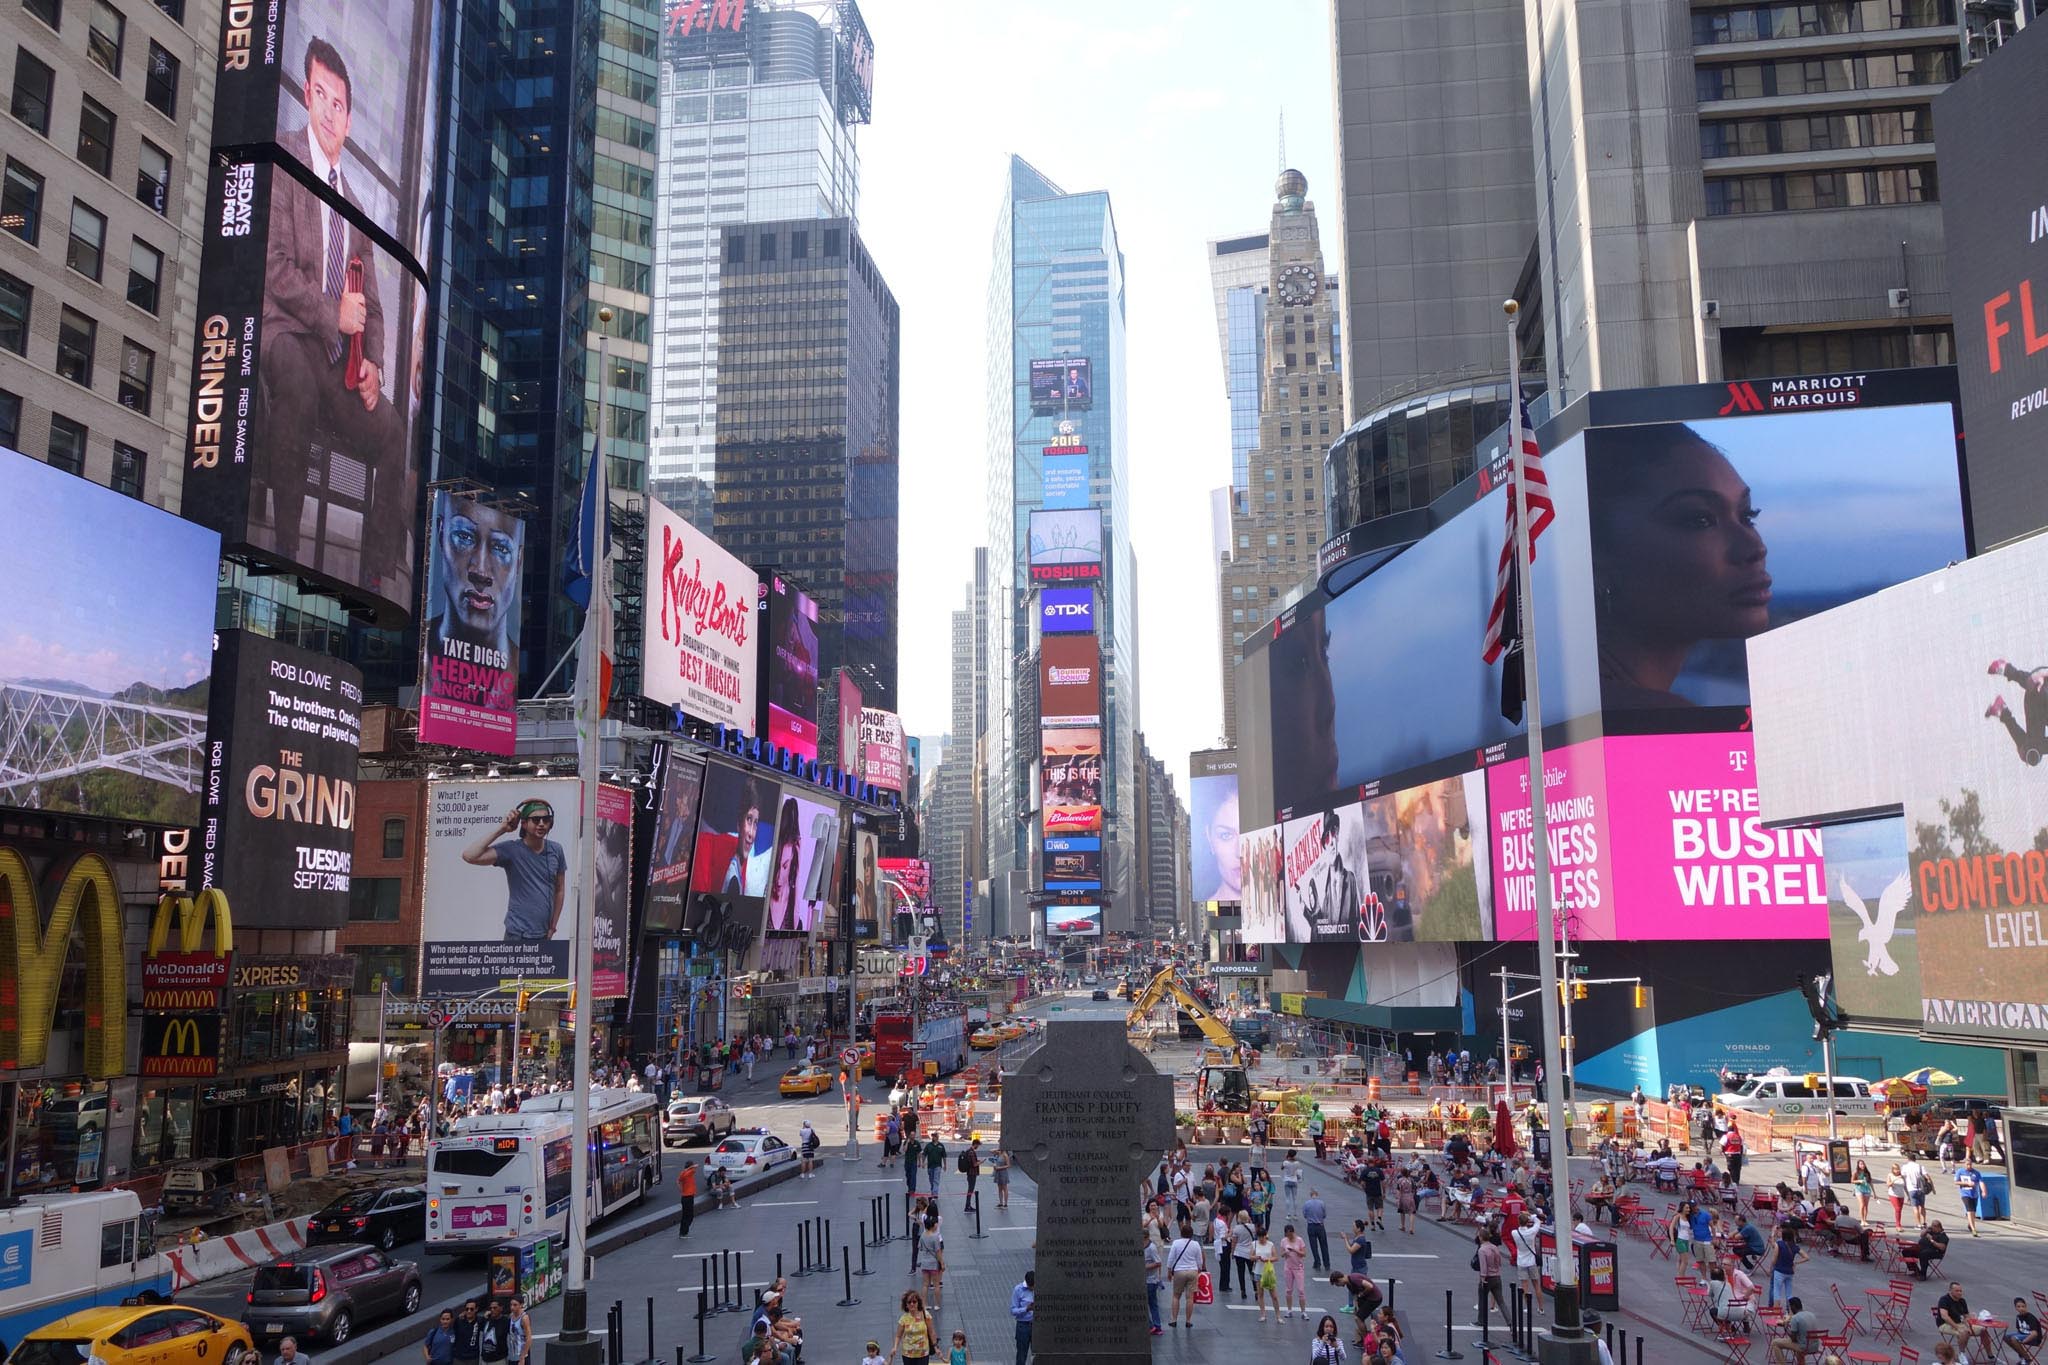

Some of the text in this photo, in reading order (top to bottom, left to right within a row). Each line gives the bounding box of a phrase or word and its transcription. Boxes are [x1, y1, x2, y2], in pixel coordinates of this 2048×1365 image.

[264, 24, 277, 64] SAVAGE
[227, 338, 237, 357] THE
[241, 317, 255, 376] ROB LOWE
[193, 314, 229, 469] GRINDER
[1772, 375, 1866, 392] MARRIOTT
[1773, 390, 1857, 407] MARQUIS
[234, 388, 249, 463] FRED SAVAGE
[1043, 446, 1087, 455] TOSHIBA
[1051, 435, 1080, 447] 2015
[1031, 564, 1101, 580] TOSHIBA
[661, 524, 749, 648] Kinky Boots
[1054, 603, 1090, 615] TDK
[443, 637, 508, 670] TAYE DIGGS
[270, 660, 358, 701] ROB LOWE FRED
[431, 655, 515, 696] HEDWIG
[680, 650, 703, 686] BEST
[704, 662, 742, 704] MUSICAL
[431, 680, 480, 703] ANGRY
[268, 690, 292, 709] Two
[293, 696, 337, 721] brothers.
[267, 709, 350, 744] The other played
[280, 749, 303, 768] THE
[1218, 763, 1238, 771] VISION
[209, 741, 223, 805] ROB LOWE
[782, 747, 879, 805] BROADWAY
[1080, 767, 1100, 780] THE
[437, 790, 479, 802] What? get
[1669, 789, 1759, 813] WE'RE
[473, 803, 490, 814] year
[1050, 812, 1094, 823] Budweiser
[436, 815, 452, 824] with
[463, 815, 503, 826] experience
[1500, 807, 1532, 832] WE'RE
[205, 818, 217, 850] FRED
[435, 827, 467, 838] or skills?
[1672, 817, 1824, 860] BUSIN
[1286, 819, 1325, 889] BLACKLIST
[1502, 822, 1598, 872] BUSNESS
[296, 846, 351, 874] TUESDAYS
[293, 870, 336, 891] SEPT 29
[1504, 868, 1600, 912] WIRLESS
[1673, 864, 1828, 906] WIREL
[1919, 850, 2048, 913] COMFOR
[1984, 910, 2048, 949] LEVEL
[430, 943, 539, 954] Who needs an education or hard
[145, 962, 226, 976] McDonald's
[430, 955, 447, 965] work
[448, 955, 466, 965] when
[467, 955, 483, 965] Gov.
[483, 954, 508, 964] Cuomo
[515, 954, 540, 966] raising
[541, 954, 553, 964] the
[1211, 963, 1258, 973] AÉROPOSTALE
[157, 976, 211, 985] Restaurant
[429, 965, 556, 977] minimum wage to 15 dollars an hour?
[384, 1002, 526, 1015] GIFTS LUGGAG
[1035, 1102, 1142, 1113] FRANCIS DUFFY
[1784, 1105, 1800, 1113] GO
[1048, 1131, 1129, 1139] CATHOLIC PRIEST
[472, 1209, 493, 1226] lyft
